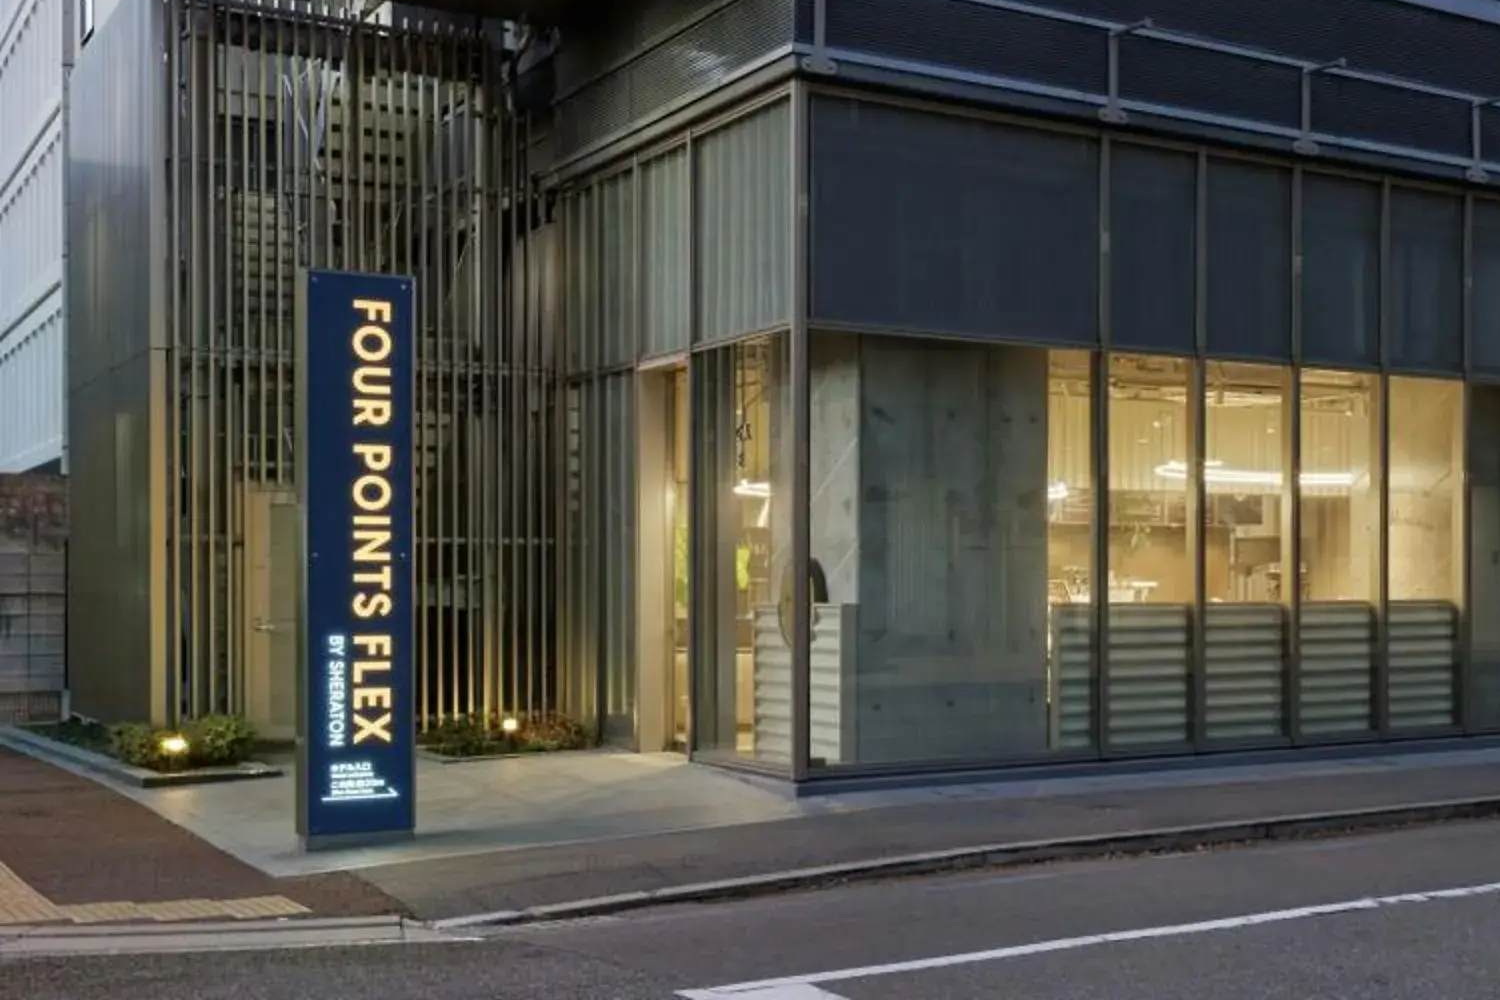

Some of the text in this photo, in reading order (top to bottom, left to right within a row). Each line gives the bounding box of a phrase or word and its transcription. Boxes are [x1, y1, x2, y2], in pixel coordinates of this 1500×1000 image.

[352, 299, 392, 426] FOUR
[352, 443, 392, 619] POINTS
[328, 634, 346, 747] BY SHERATON
[352, 635, 392, 745] FLEX
